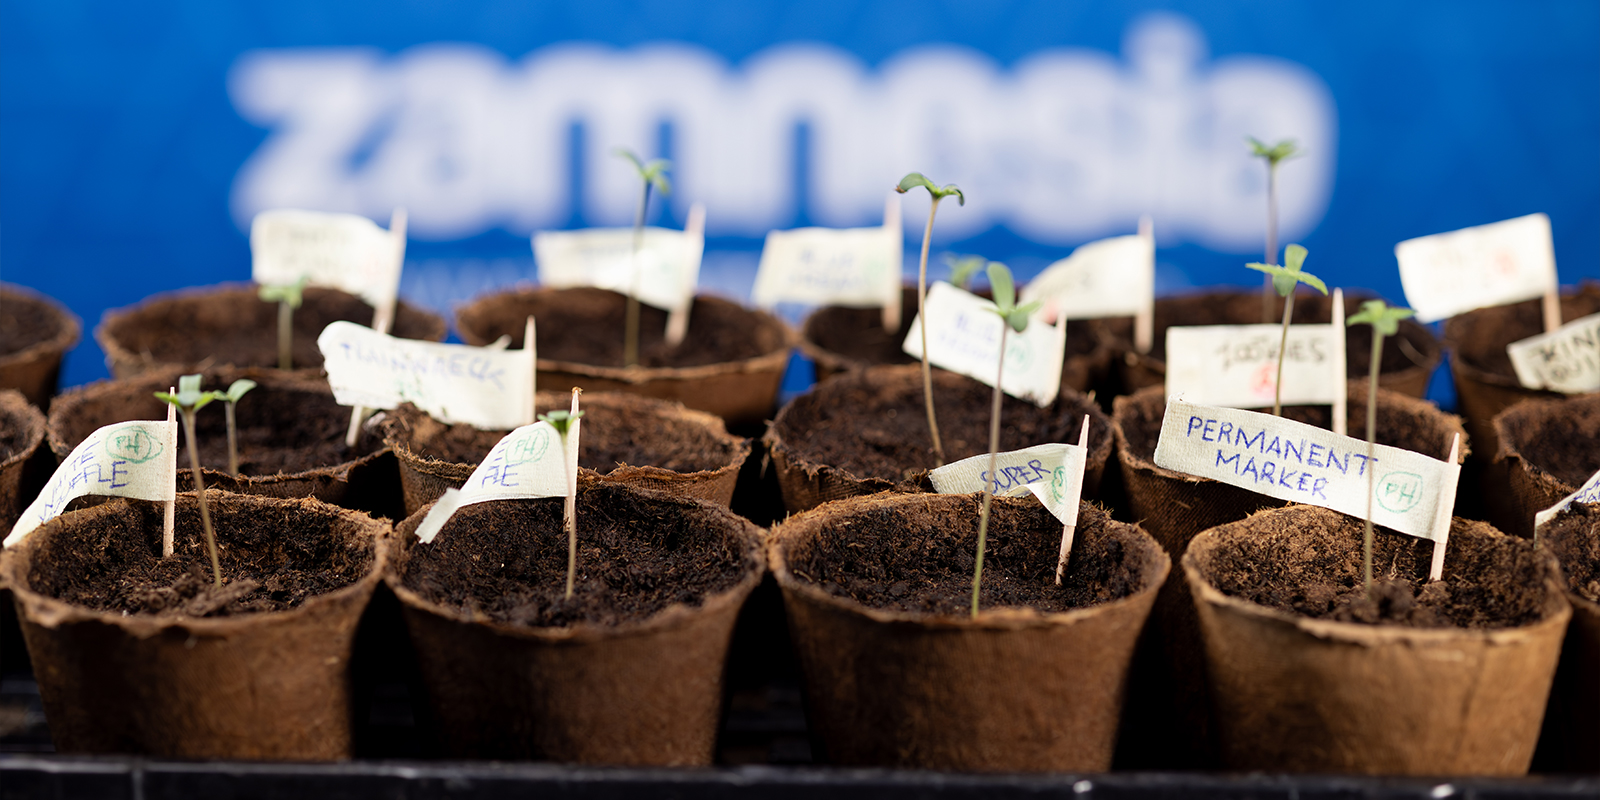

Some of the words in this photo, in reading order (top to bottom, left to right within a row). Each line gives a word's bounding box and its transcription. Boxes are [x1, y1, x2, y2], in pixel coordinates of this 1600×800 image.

[1187, 416, 1378, 476] PERMANENT
[980, 459, 1051, 494] SUPER
[1216, 449, 1327, 499] MARKER
